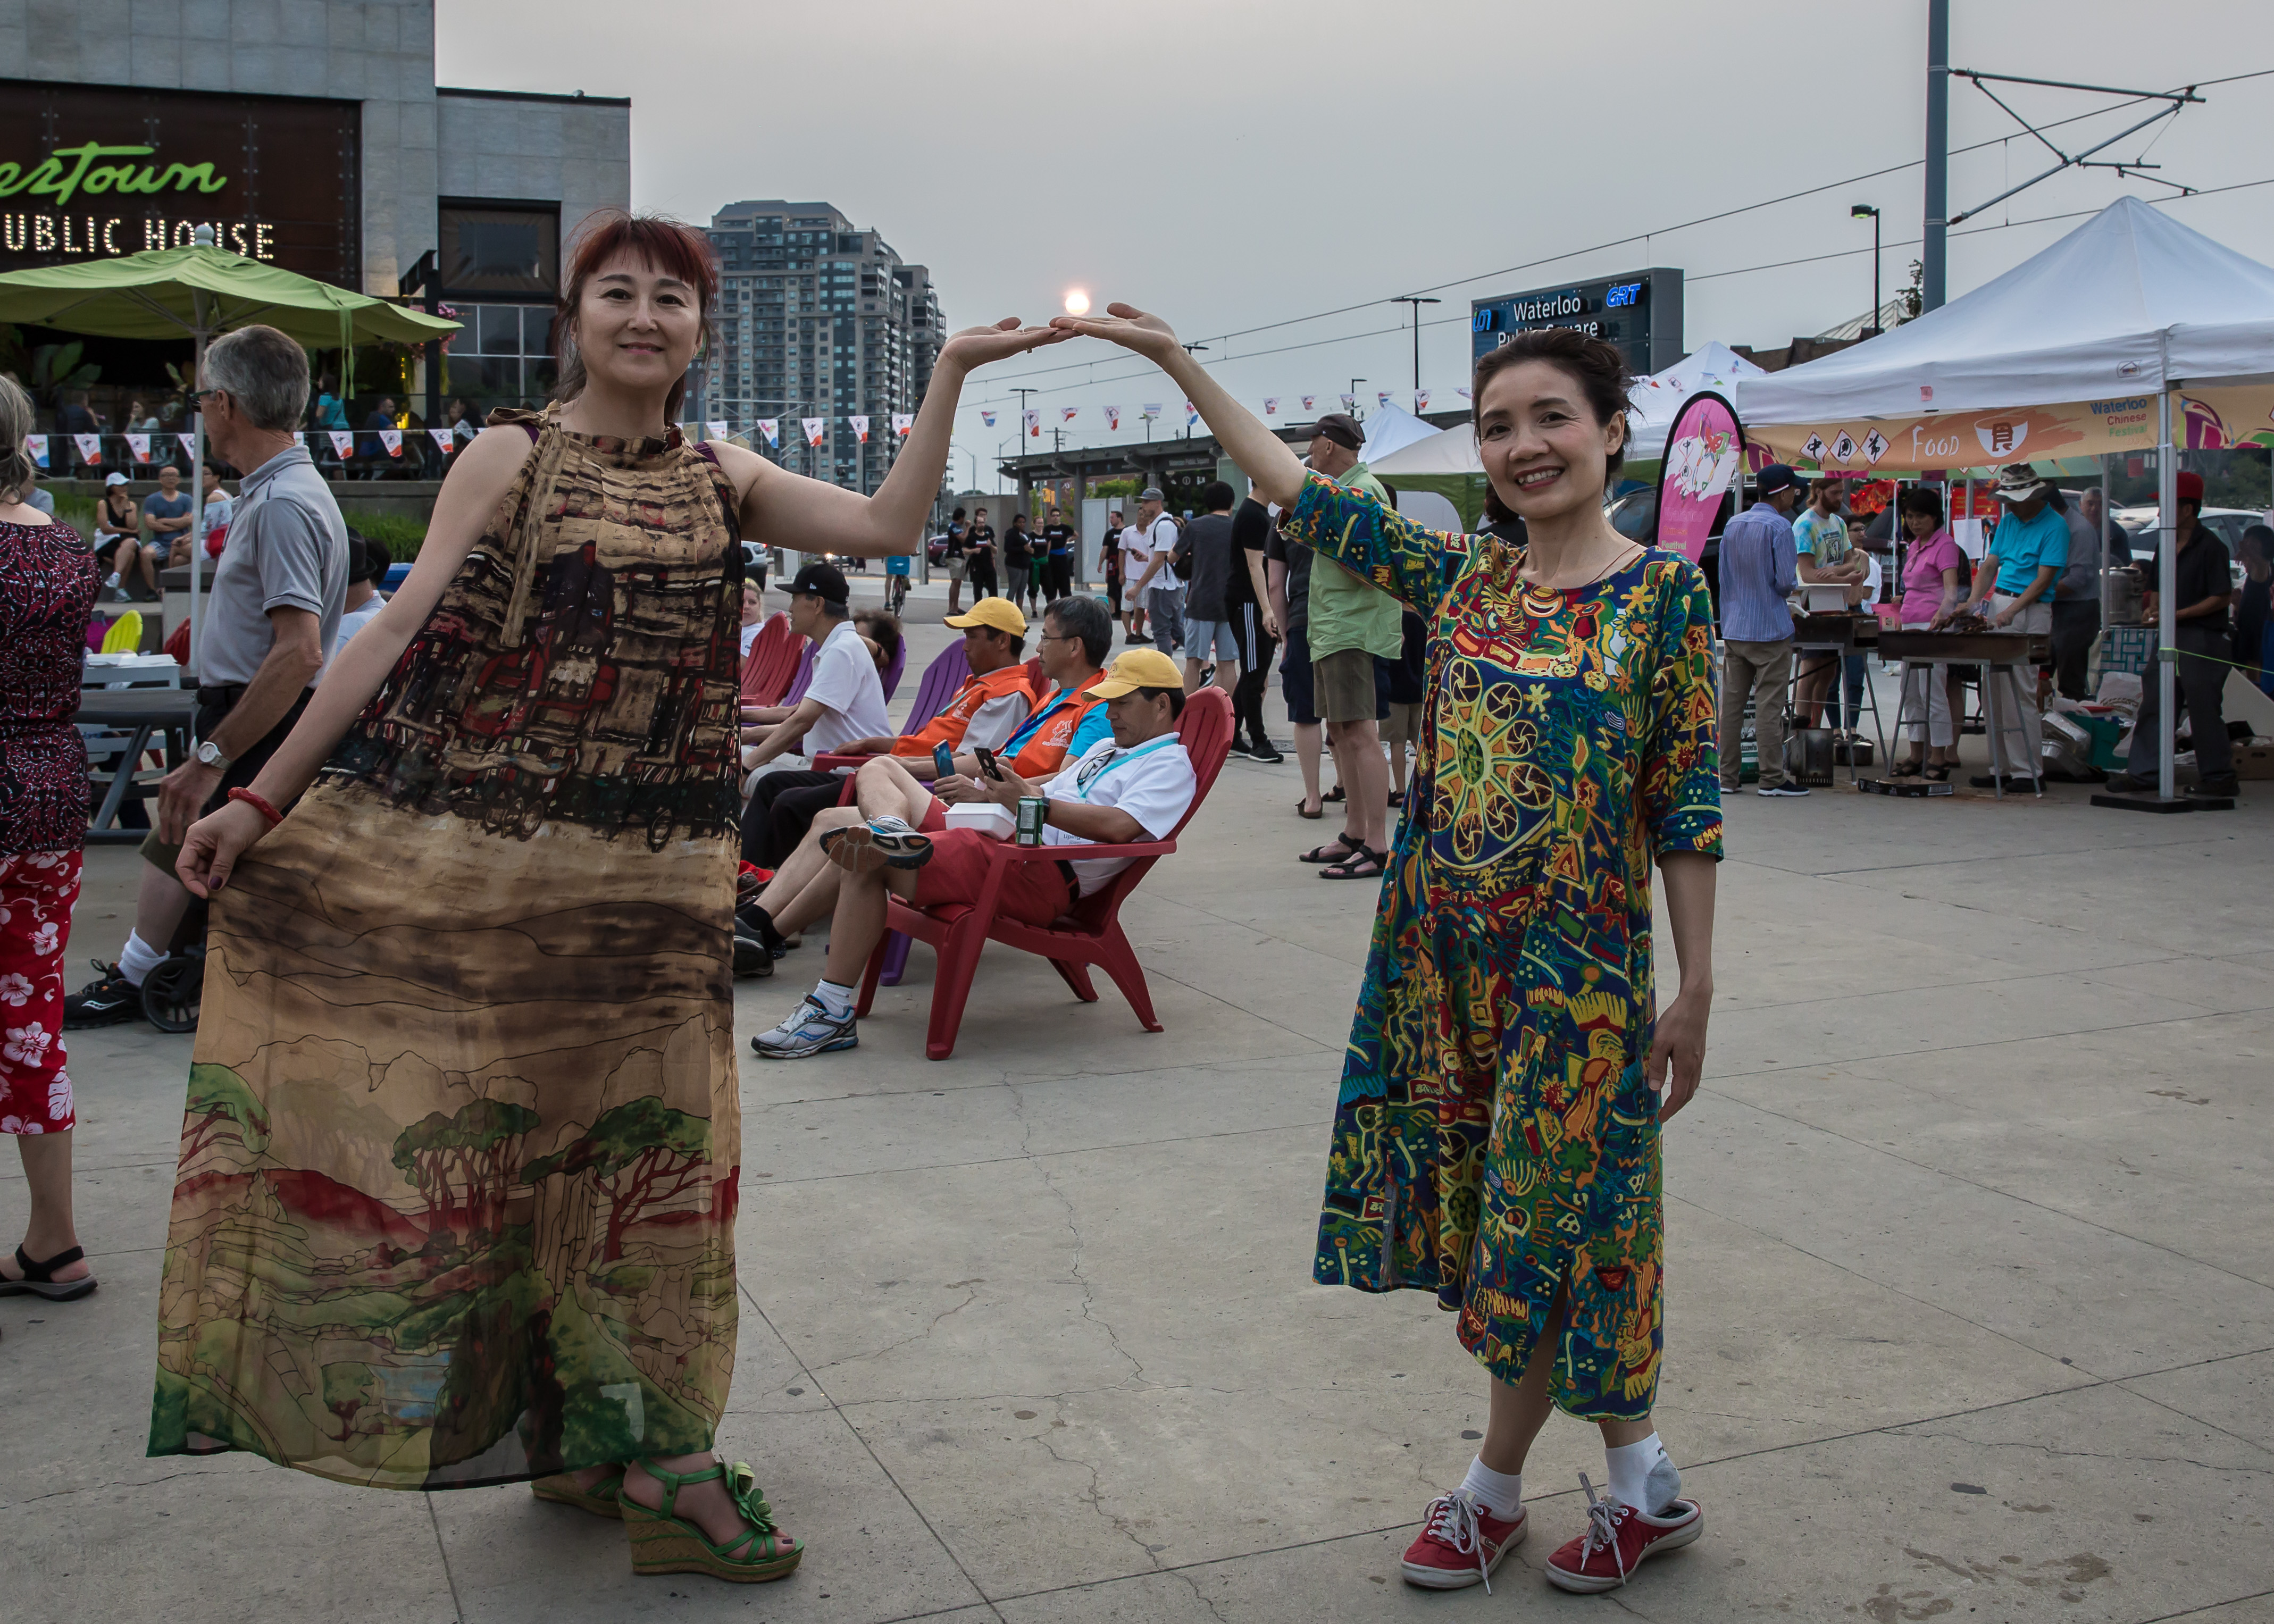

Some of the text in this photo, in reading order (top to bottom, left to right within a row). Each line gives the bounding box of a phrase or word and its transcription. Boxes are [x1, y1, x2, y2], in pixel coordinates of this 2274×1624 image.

[4, 214, 121, 254] UBLIC
[1606, 283, 1641, 308] GRT
[1514, 295, 1581, 322] Waterloo
[2089, 398, 2147, 415] Waterloo
[2107, 413, 2147, 425] Chinese
[2109, 424, 2147, 437] Festival
[1661, 540, 1686, 550] Festival
